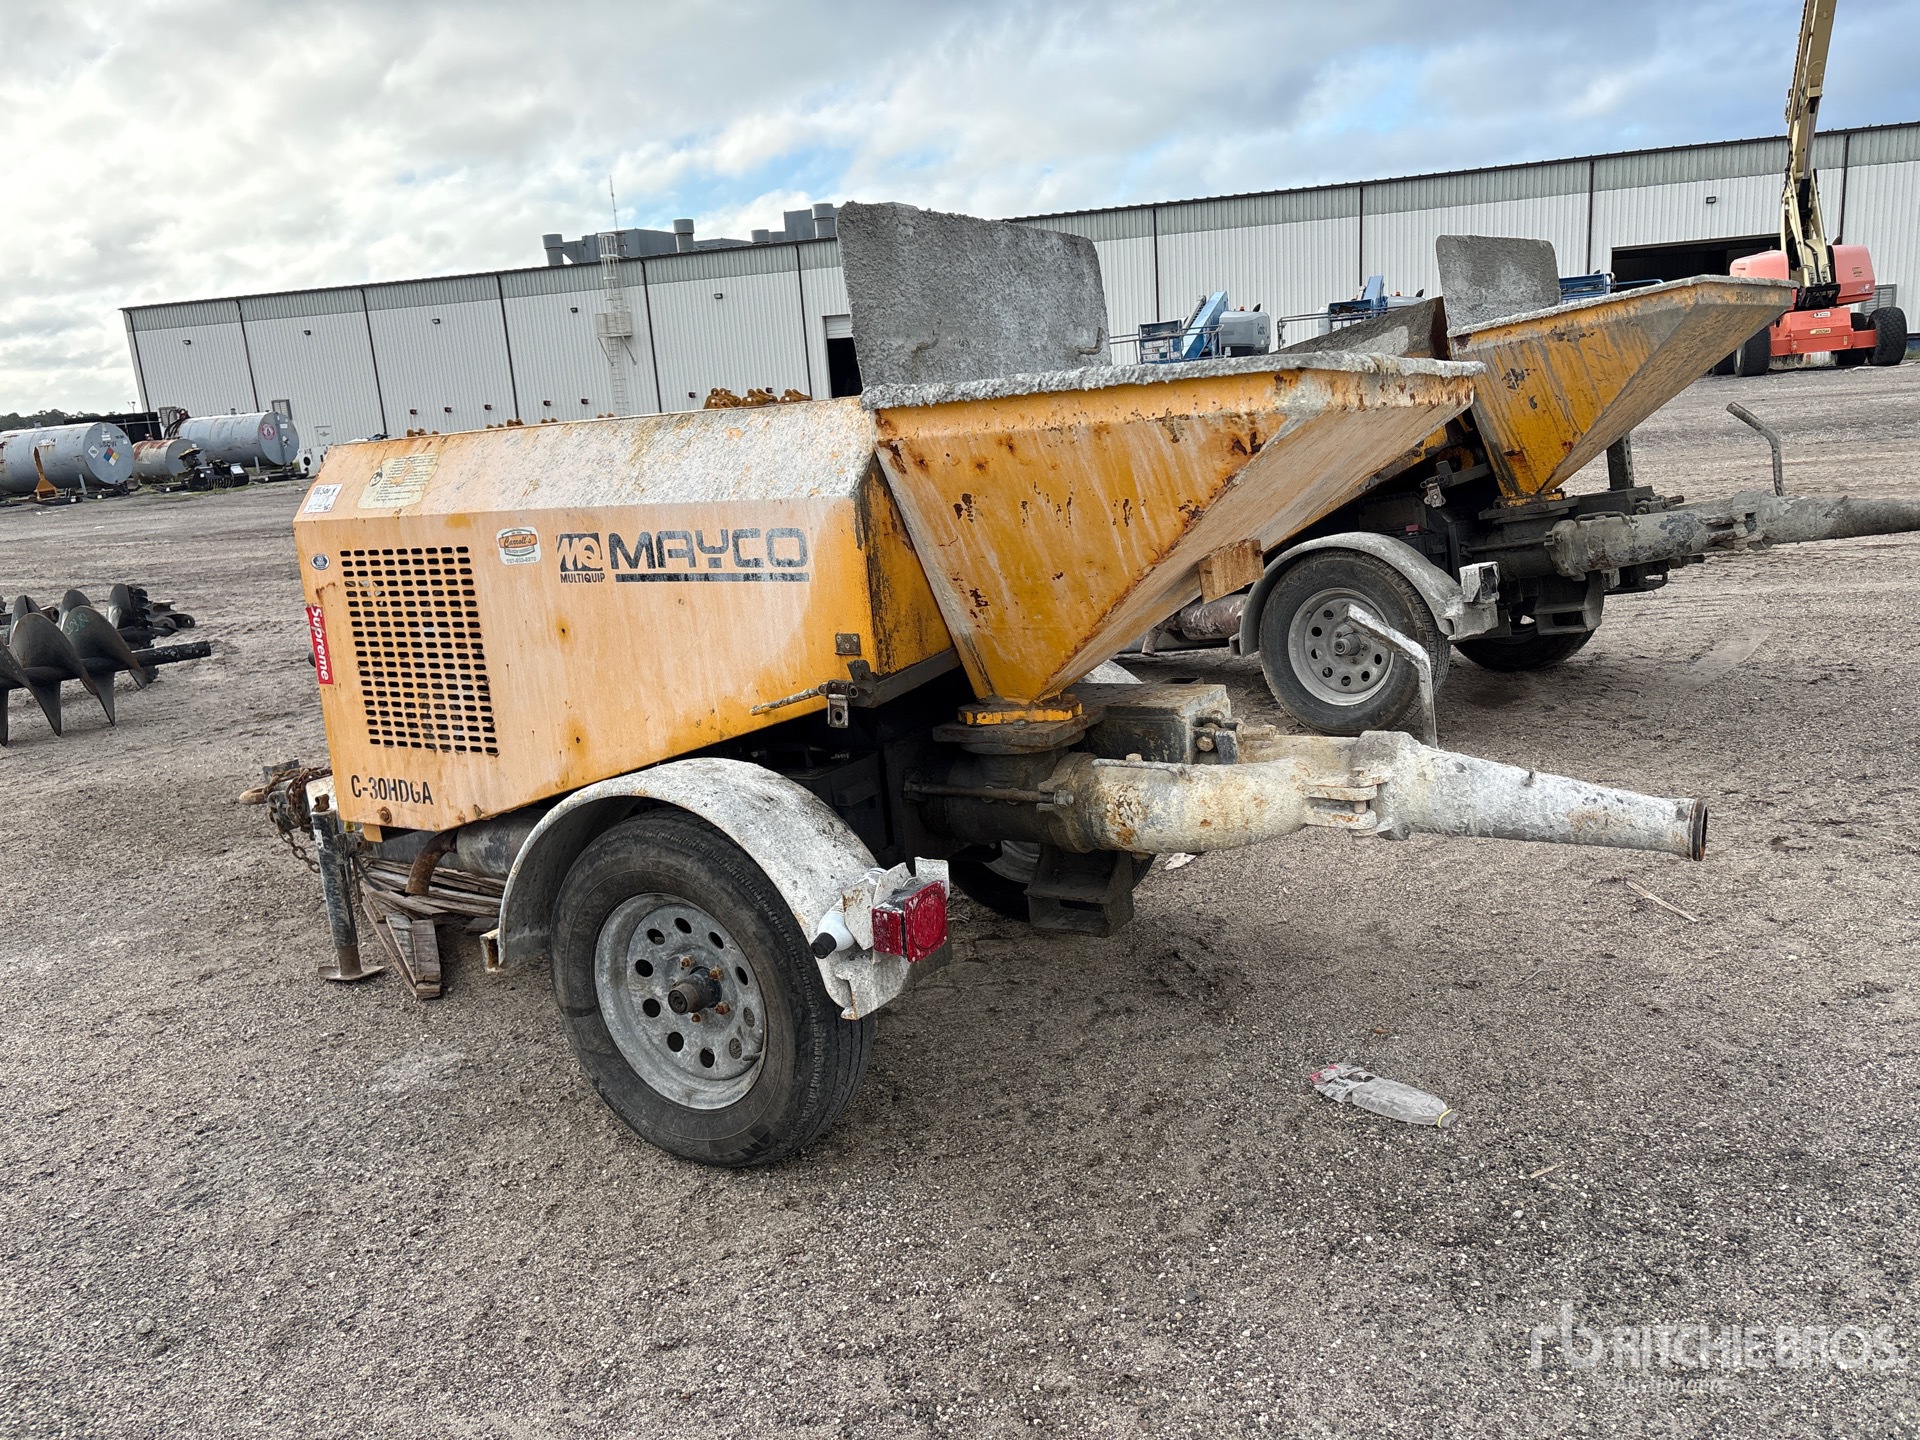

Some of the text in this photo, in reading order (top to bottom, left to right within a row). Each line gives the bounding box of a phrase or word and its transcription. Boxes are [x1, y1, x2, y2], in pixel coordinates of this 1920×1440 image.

[503, 536, 532, 548] Carroll's
[556, 533, 603, 572] MQ
[608, 527, 808, 570] MAYCO
[560, 573, 606, 584] MULTIQUIP
[311, 606, 329, 681] Supreme
[351, 774, 434, 805] C-30HDGA
